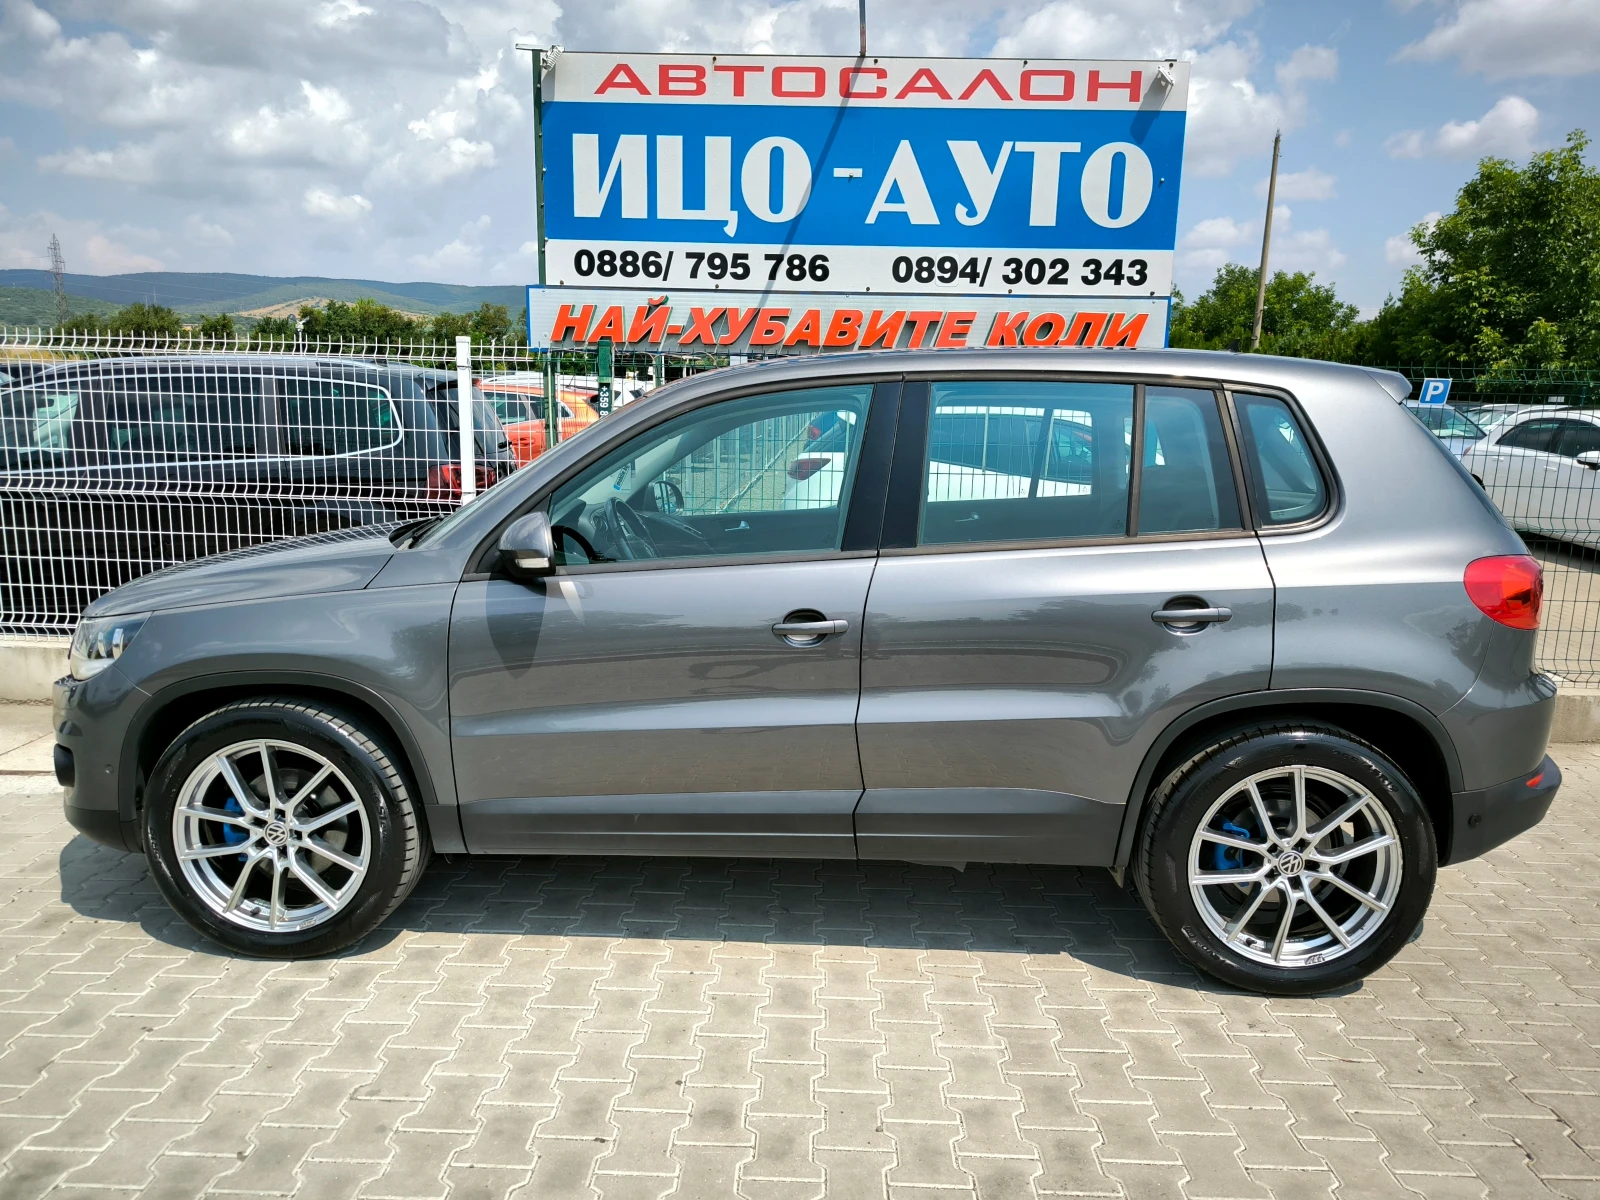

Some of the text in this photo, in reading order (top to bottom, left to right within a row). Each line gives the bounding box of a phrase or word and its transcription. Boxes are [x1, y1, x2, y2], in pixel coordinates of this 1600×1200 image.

[595, 64, 1142, 103] АВТОСАЛОН
[575, 250, 829, 281] 0886/ 795 786
[893, 256, 1147, 287] 0894/ 302 343
[551, 296, 1148, 348] НАЙ-ХУБАВИТЕ КОЛИ
[600, 385, 609, 418] +359 8
[1424, 381, 1444, 402] P
